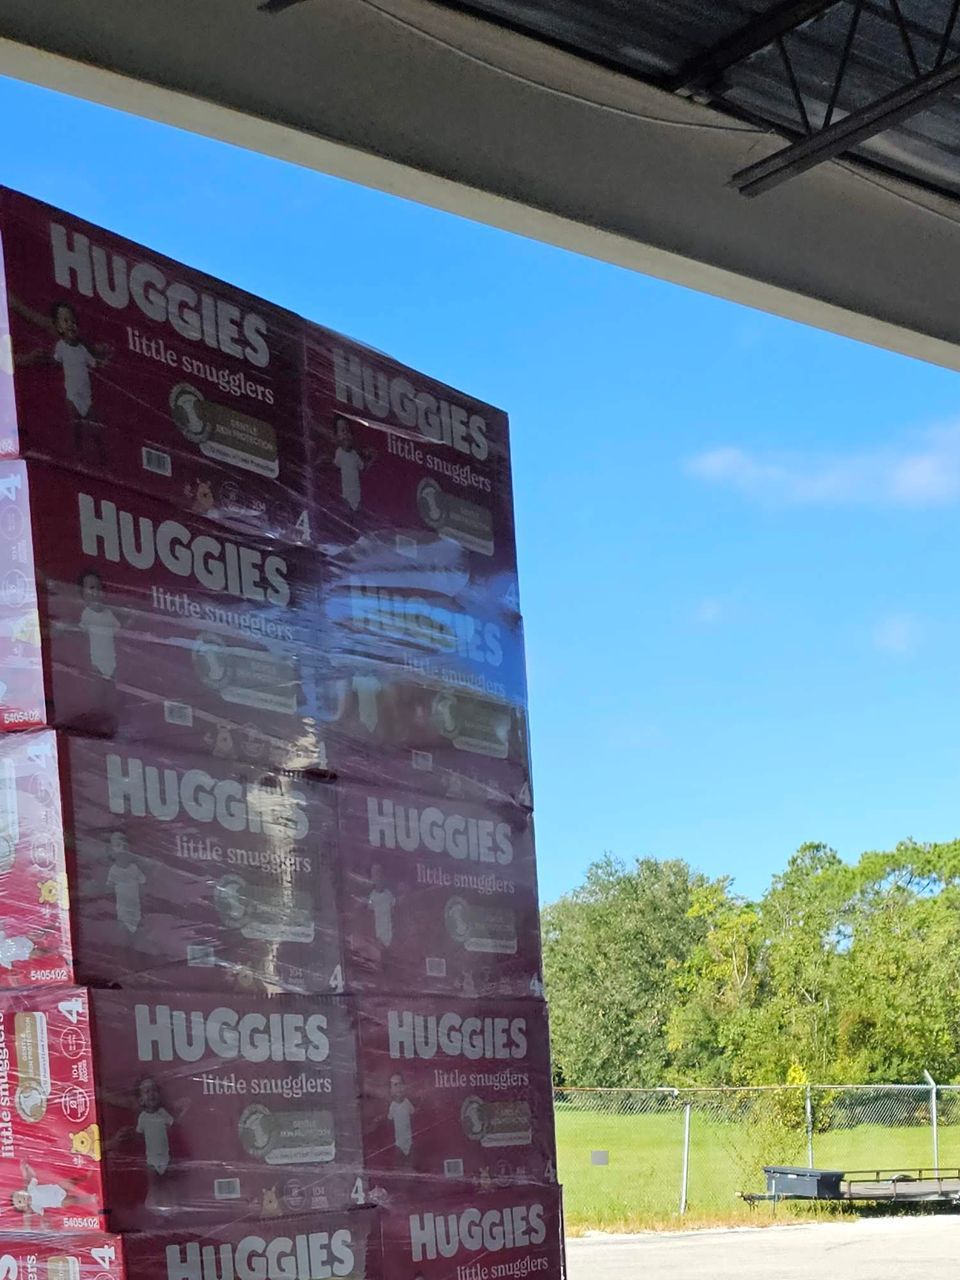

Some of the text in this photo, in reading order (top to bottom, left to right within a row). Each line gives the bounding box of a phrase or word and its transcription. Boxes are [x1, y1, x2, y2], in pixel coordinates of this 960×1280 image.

[51, 220, 270, 367] HUGGIES
[127, 326, 275, 405] little snugglers
[333, 348, 488, 460] HUGGIES
[387, 431, 491, 492] little snugglers
[79, 492, 290, 607] HUGGIES
[151, 586, 200, 618] little
[106, 754, 309, 840] HUGGIES
[367, 797, 513, 865] HUGGIES
[175, 835, 222, 860] little
[416, 863, 515, 895] little snugglers
[329, 964, 344, 993] 4
[529, 973, 541, 997] 4
[58, 998, 86, 1024] 4
[135, 1004, 330, 1063] HUGGIES
[388, 1010, 527, 1060] HUGGIES
[202, 1073, 332, 1099] little snugglers
[434, 1069, 528, 1090] little snugglers
[351, 1177, 365, 1205] 4
[410, 1204, 546, 1262] HUGGIES
[91, 1245, 116, 1270] 4
[491, 1255, 549, 1278] snugglers
